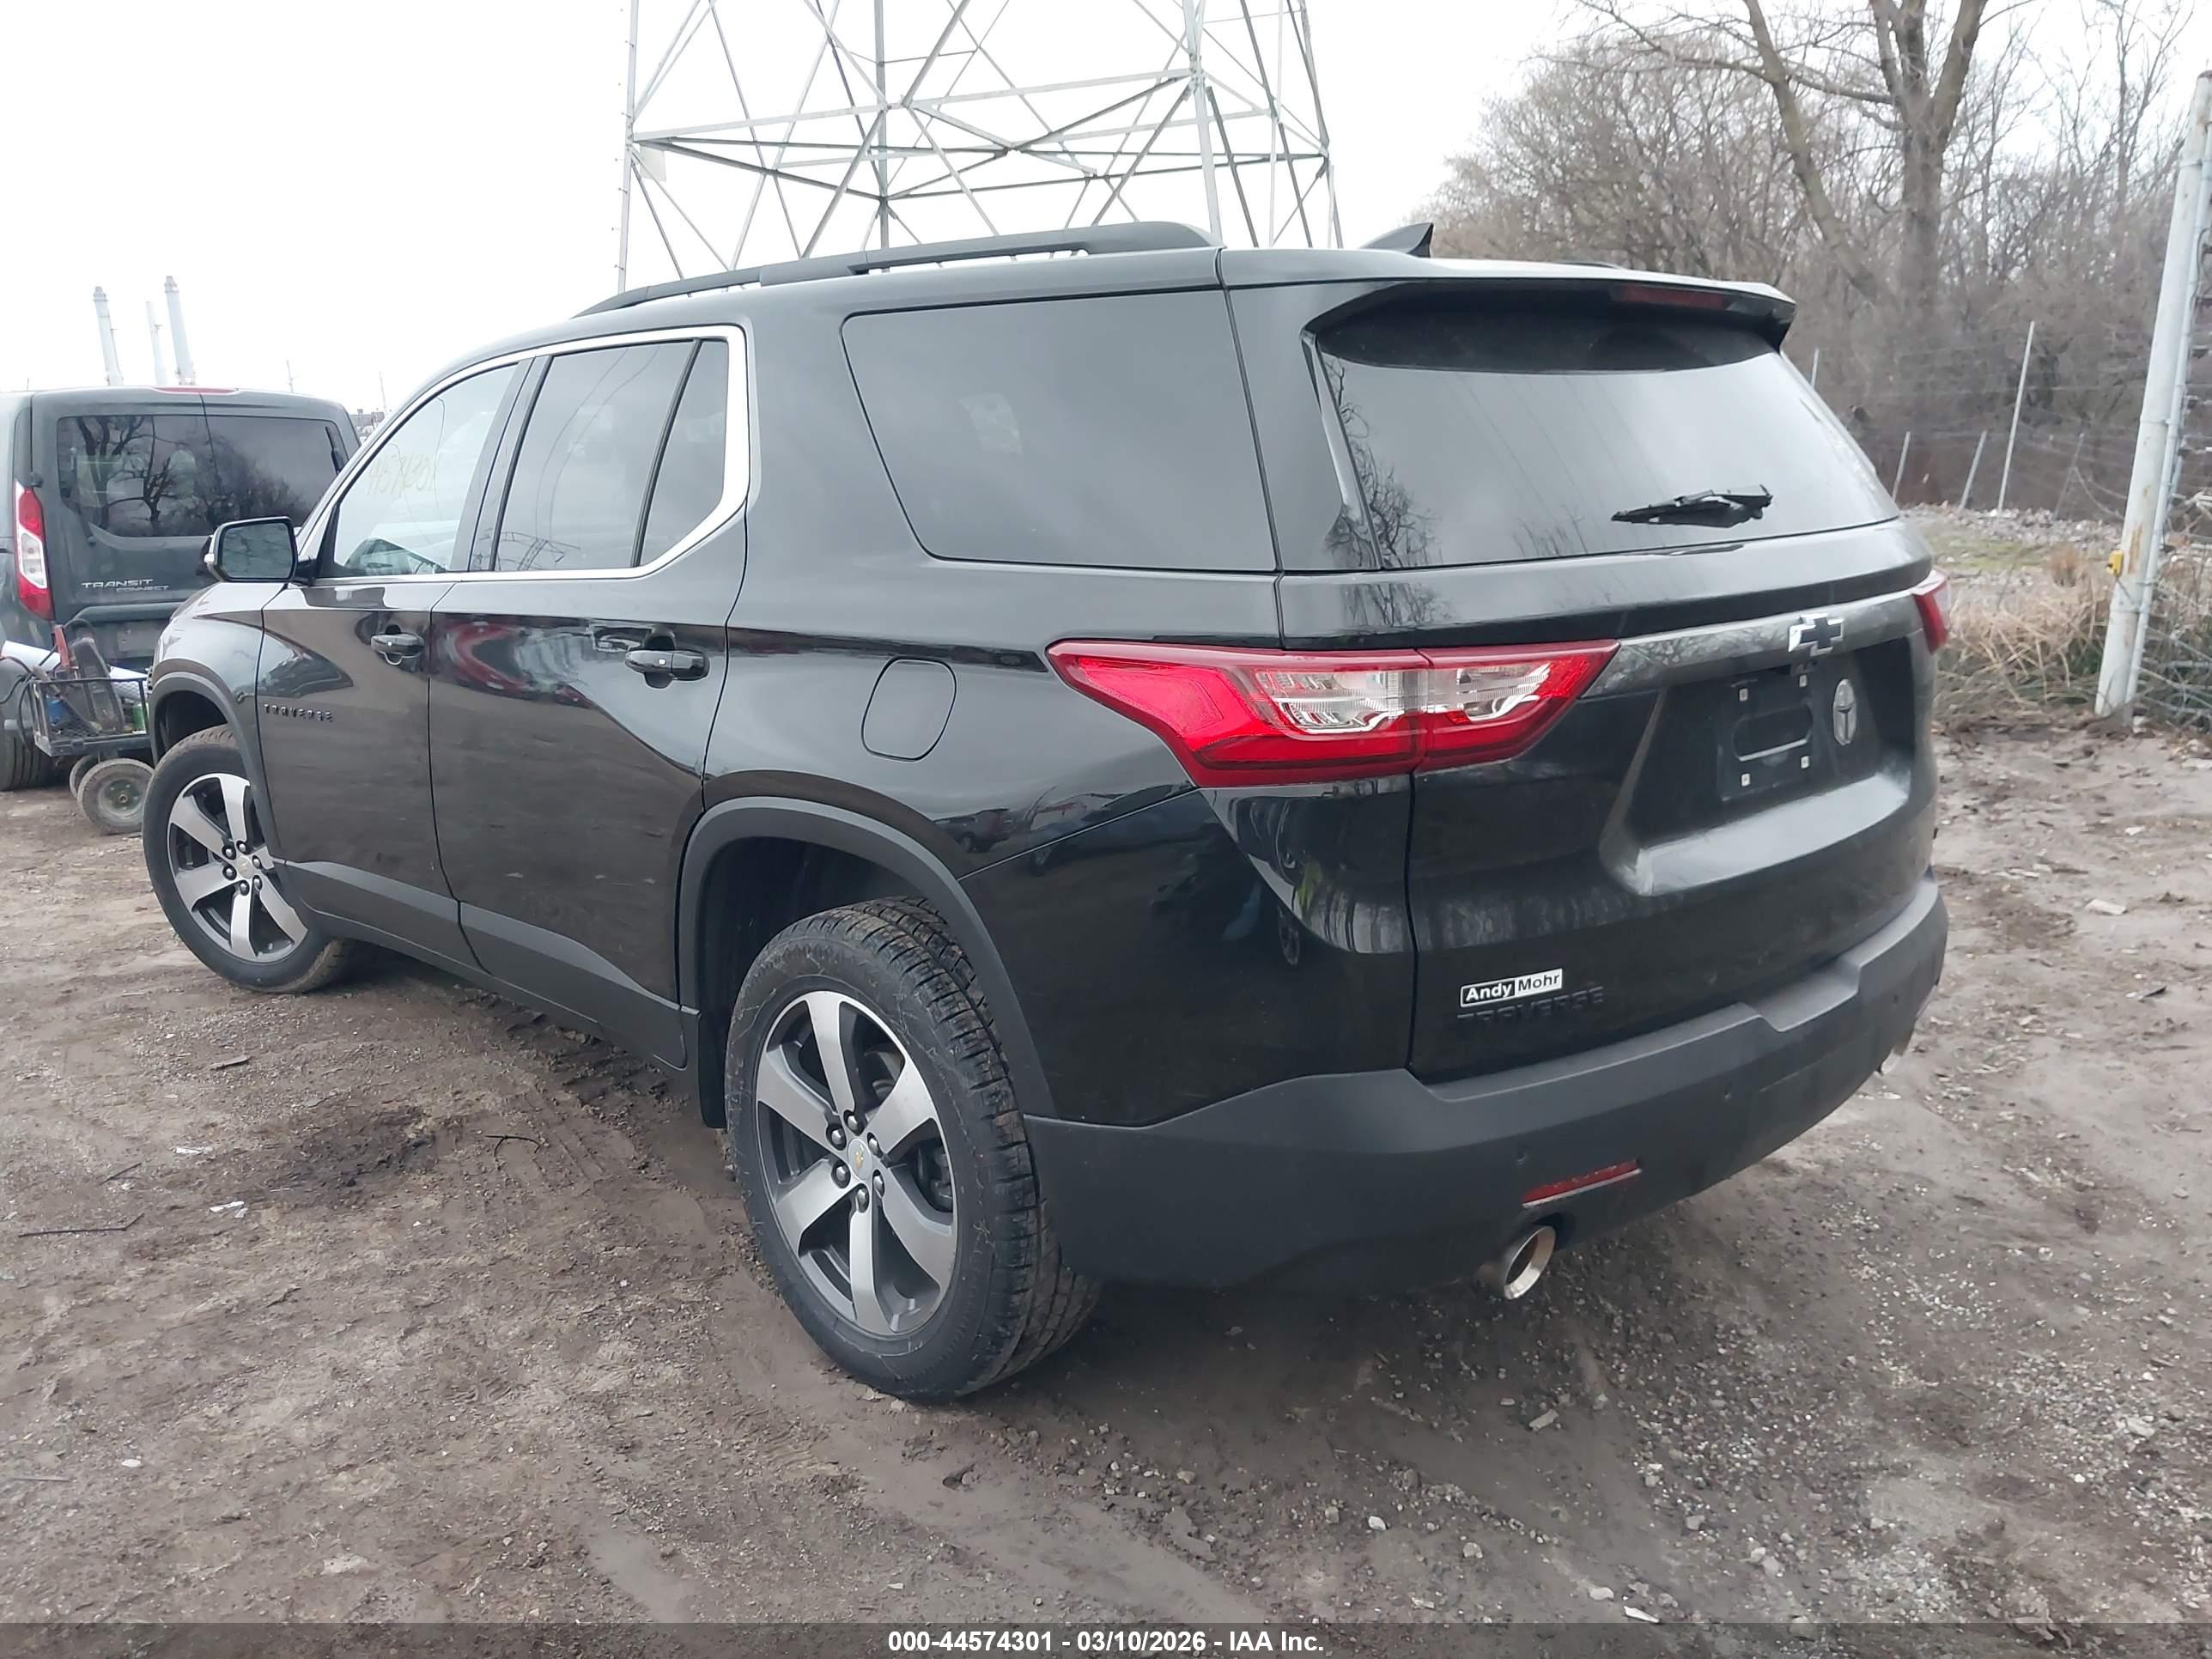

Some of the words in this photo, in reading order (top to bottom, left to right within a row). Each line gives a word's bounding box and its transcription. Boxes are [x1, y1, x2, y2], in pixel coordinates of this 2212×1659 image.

[82, 579, 153, 588] TRANSIT
[1465, 982, 1512, 1001] Andy
[1518, 975, 1559, 991] Mohr
